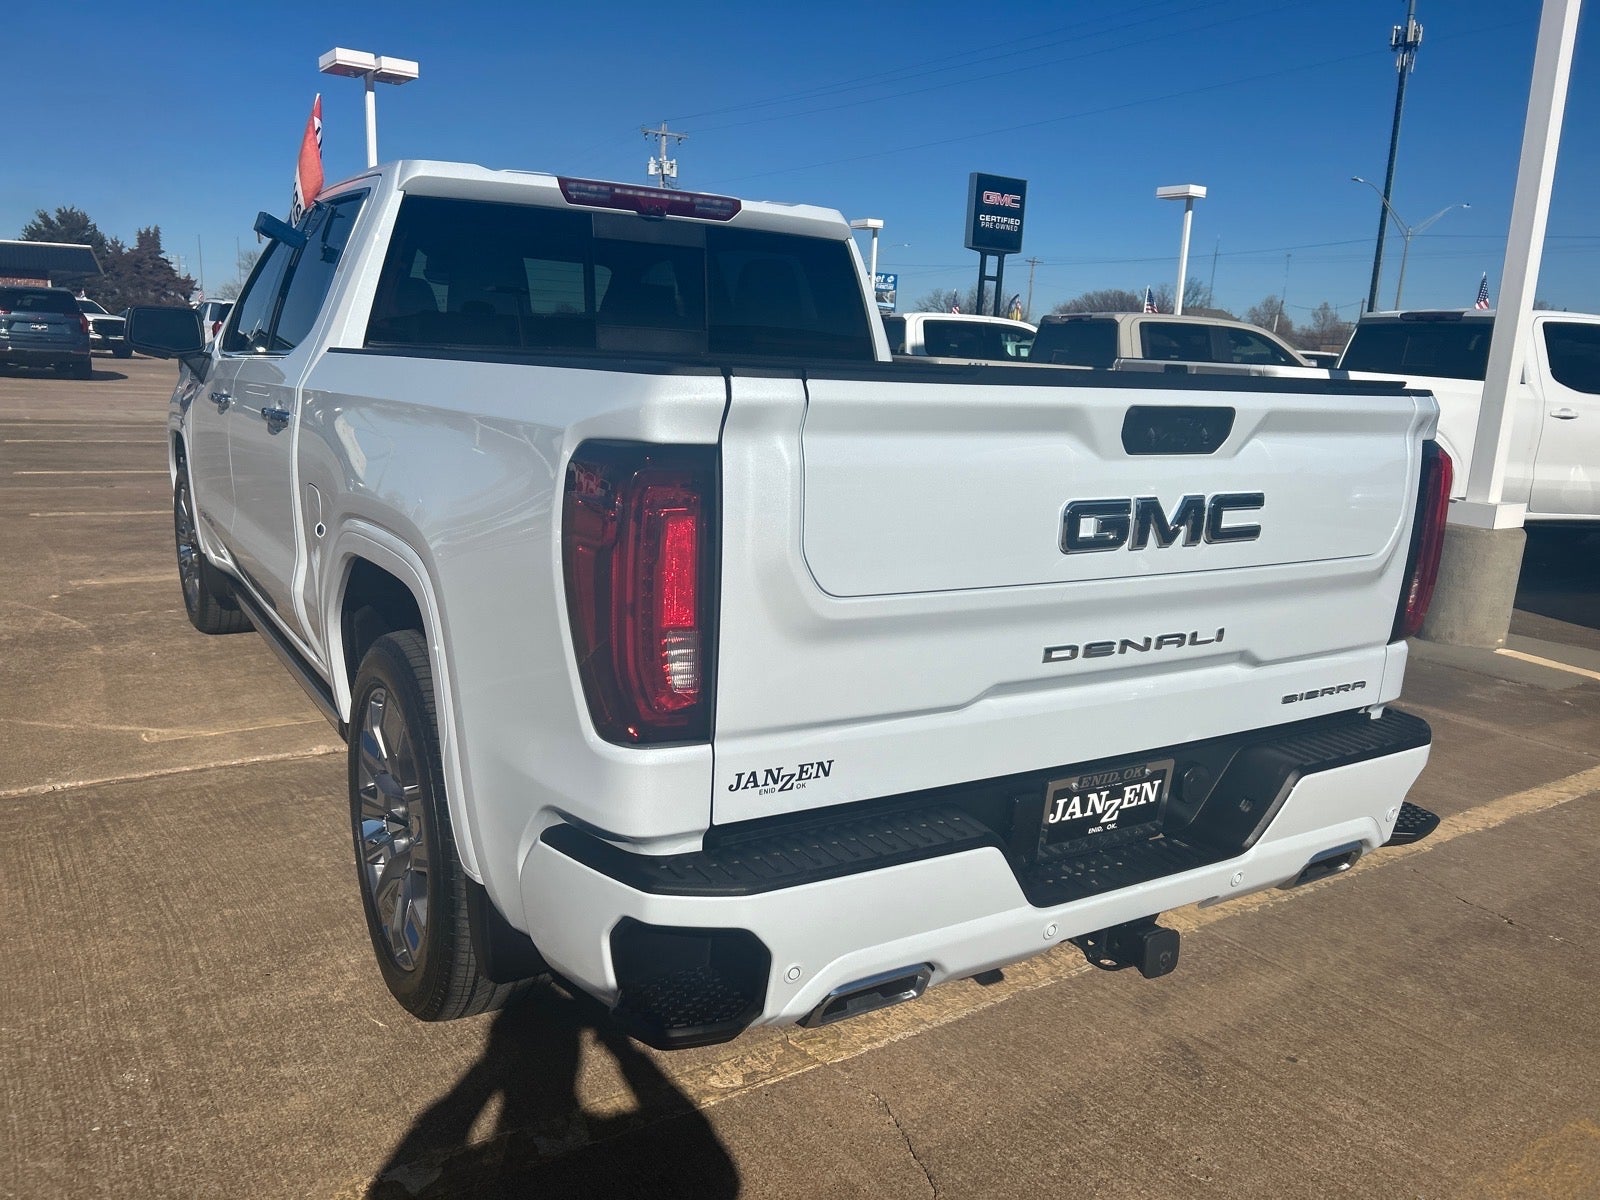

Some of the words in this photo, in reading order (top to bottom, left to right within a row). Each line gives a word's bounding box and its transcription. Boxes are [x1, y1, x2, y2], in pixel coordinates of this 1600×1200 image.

[983, 190, 1021, 208] GMC
[979, 214, 1021, 226] CERTIFIED
[981, 221, 1018, 232] PRE-OWNED
[1058, 491, 1265, 554] GMC
[1041, 626, 1225, 664] DENALI
[1281, 680, 1367, 705] SIERRA
[728, 759, 835, 792] JANZEN
[758, 787, 776, 796] ENID
[795, 782, 807, 790] OK
[1048, 779, 1162, 824] JANZEN
